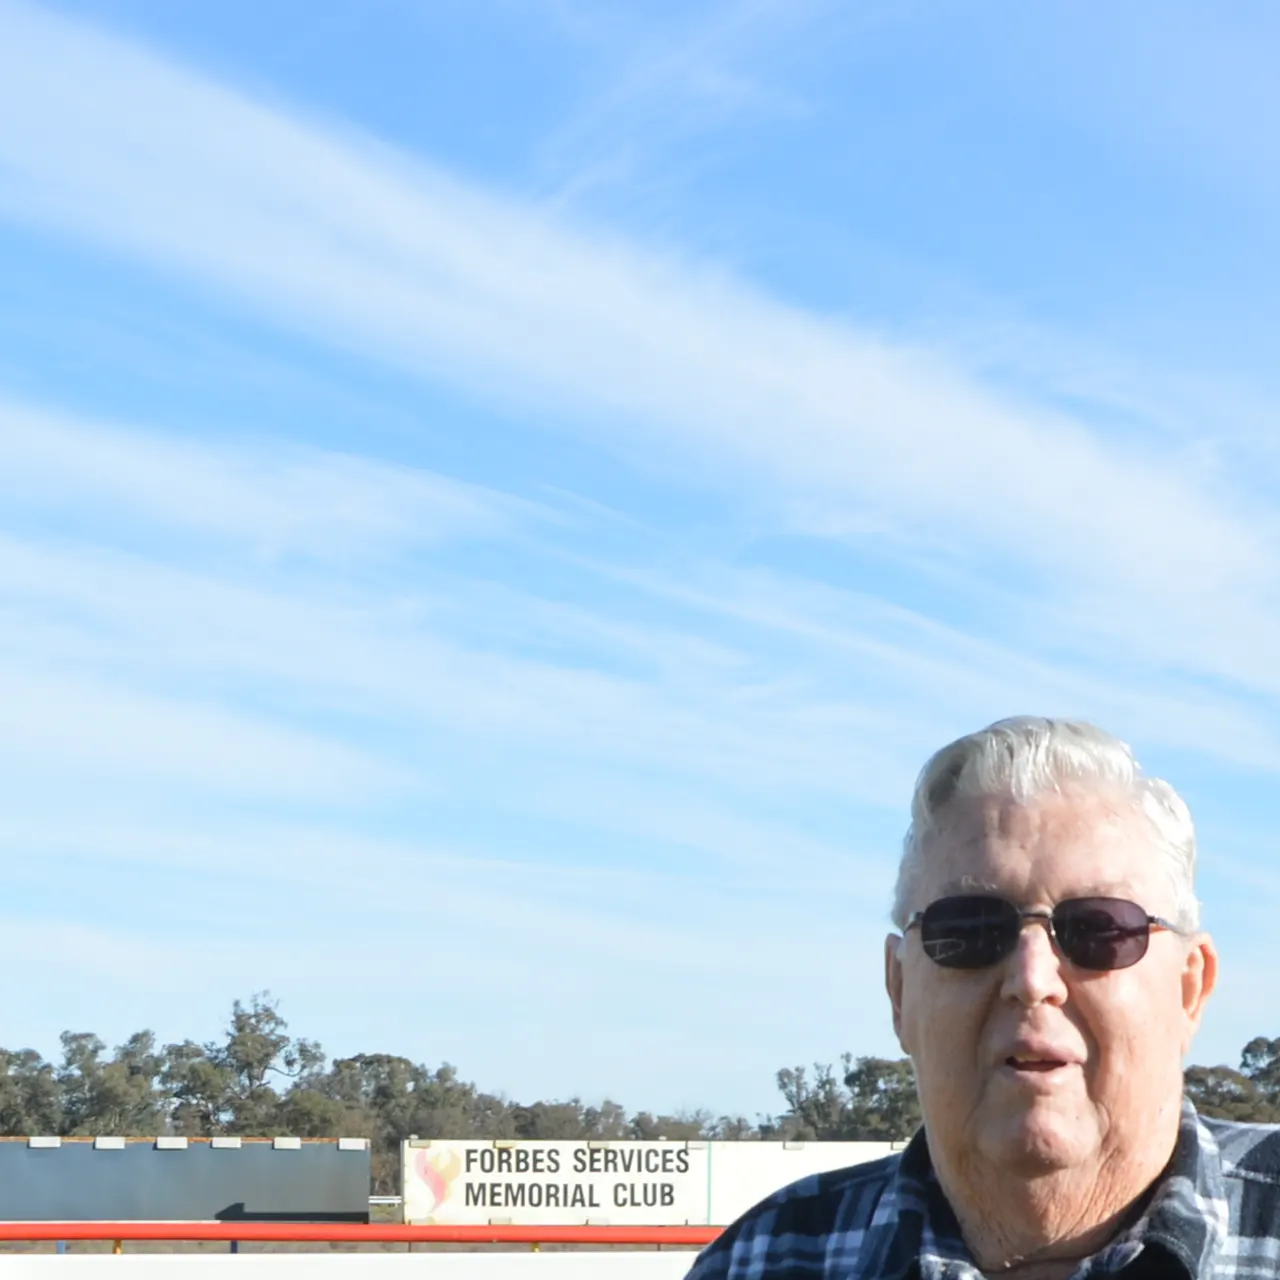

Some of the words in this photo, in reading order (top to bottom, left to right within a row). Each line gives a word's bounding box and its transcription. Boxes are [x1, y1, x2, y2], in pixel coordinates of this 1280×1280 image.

[465, 1148, 561, 1174] FORBES
[573, 1148, 690, 1174] SERVICES
[465, 1182, 601, 1208] MEMORIAL
[613, 1182, 676, 1208] CLUB
